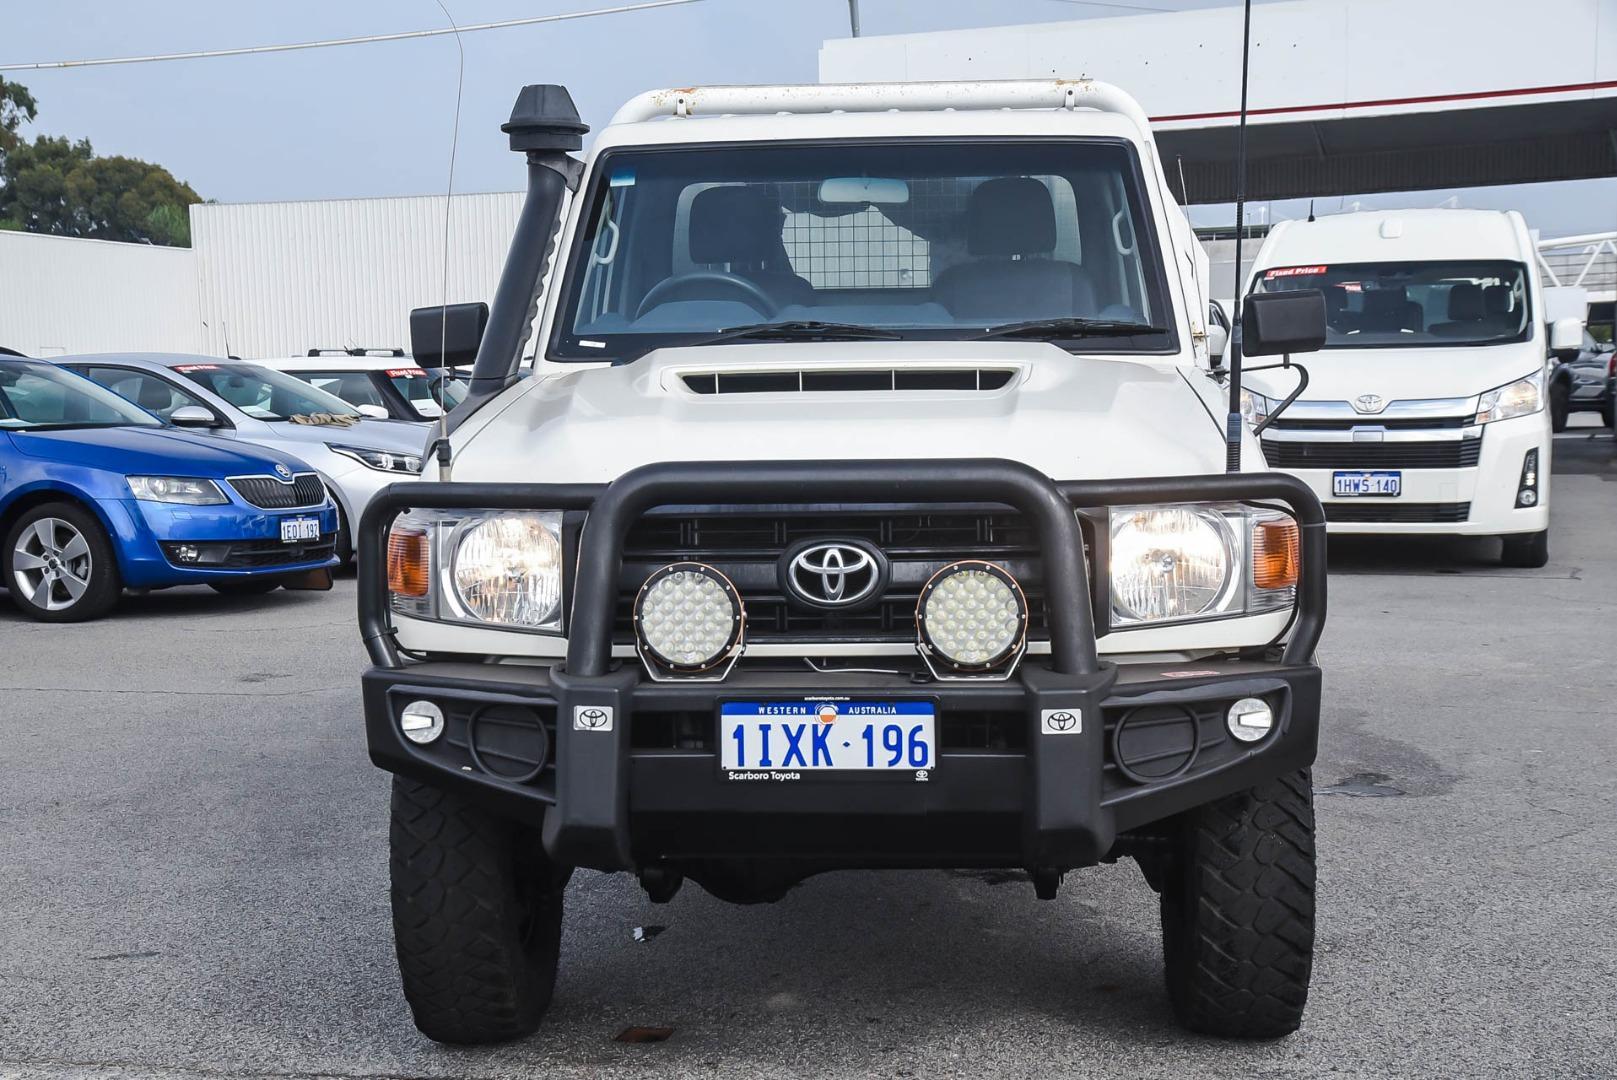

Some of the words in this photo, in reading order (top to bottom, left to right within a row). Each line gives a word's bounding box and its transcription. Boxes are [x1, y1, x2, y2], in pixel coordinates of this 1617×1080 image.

[758, 706, 806, 715] WESTERN
[848, 706, 897, 715] AUSTRALIA
[728, 771, 769, 780] Scarboro
[770, 771, 801, 782] Toyota
